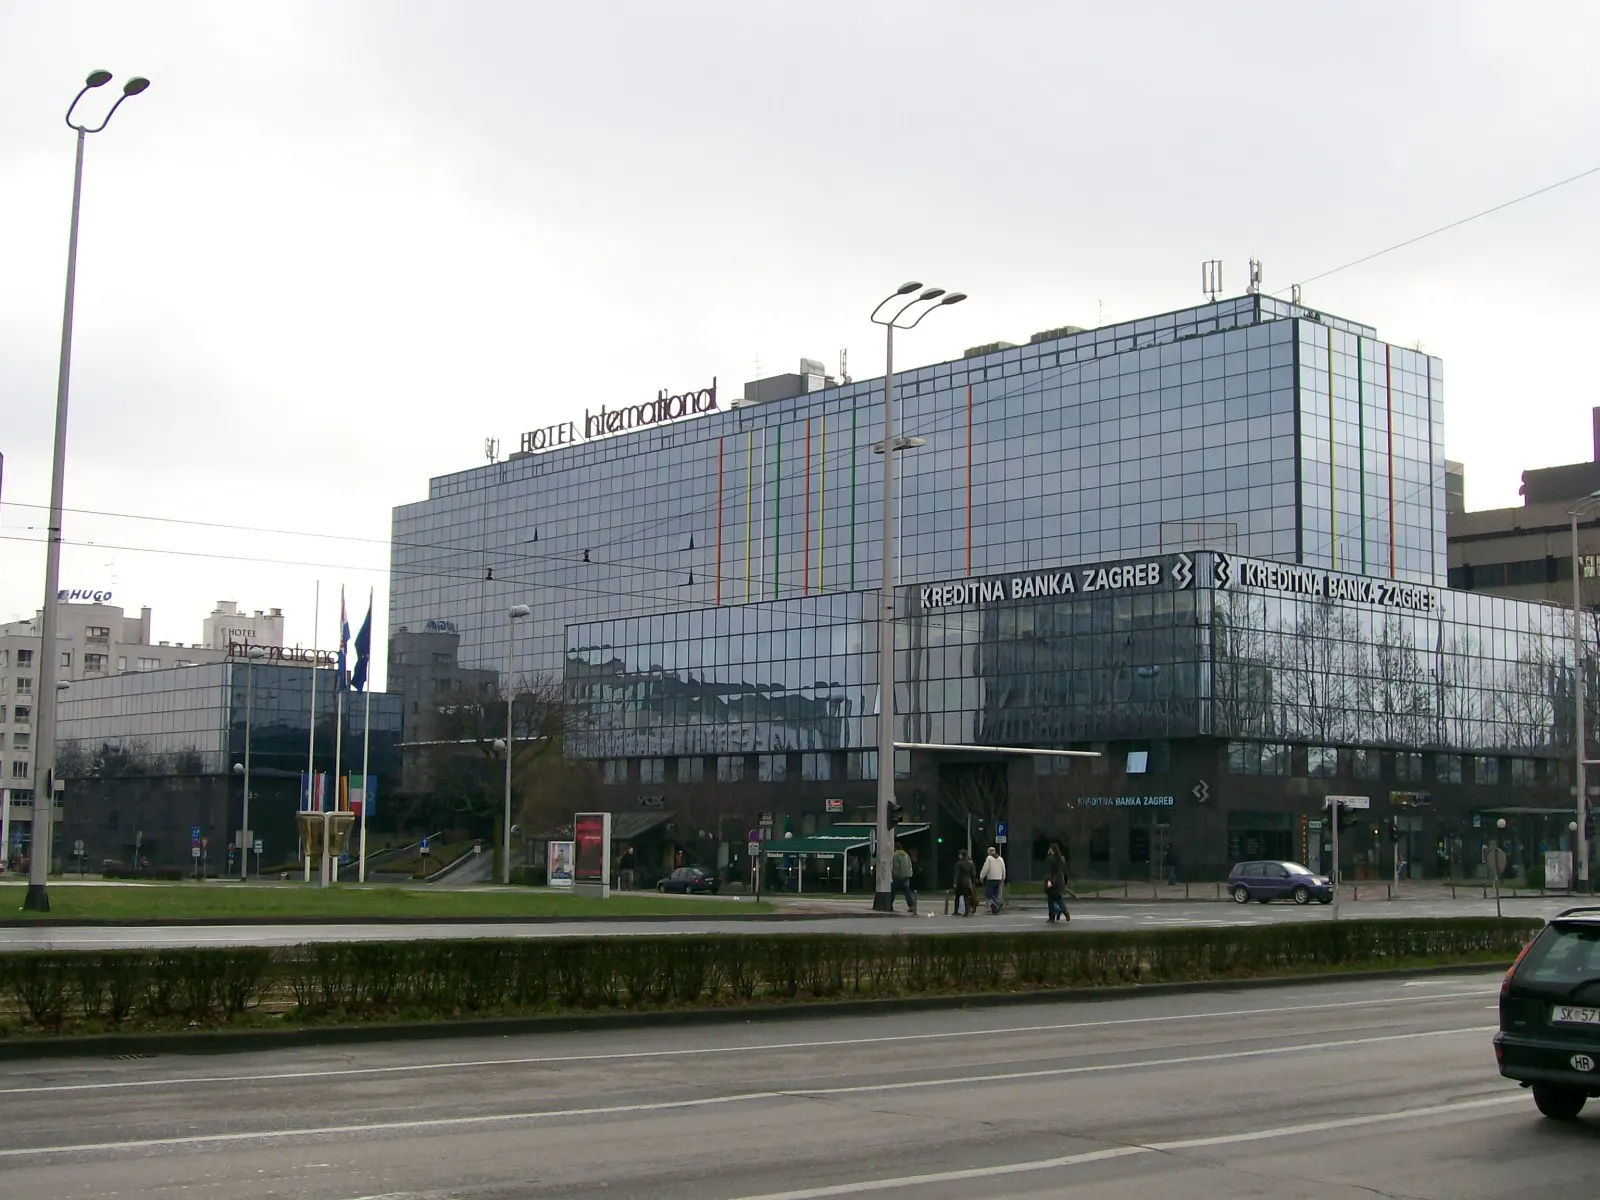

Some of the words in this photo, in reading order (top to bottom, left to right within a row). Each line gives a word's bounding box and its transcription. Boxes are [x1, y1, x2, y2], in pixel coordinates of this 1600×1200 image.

[521, 421, 575, 453] HOTEL
[585, 376, 717, 439] International
[920, 582, 1005, 609] KREDITNA
[1011, 572, 1075, 599] BANKA
[1082, 563, 1160, 591] ZAGREB
[1244, 563, 1322, 596] KREDITNA
[1328, 576, 1377, 604] BANKA
[1379, 585, 1438, 613] ZAGREB
[69, 589, 112, 602] HUGO
[228, 628, 256, 638] HOTEL
[1115, 796, 1141, 806] BANKA
[1143, 796, 1174, 806] ZAGREB
[998, 824, 1004, 834] P
[1561, 1007, 1573, 1021] SK
[1574, 1055, 1590, 1070] HR
